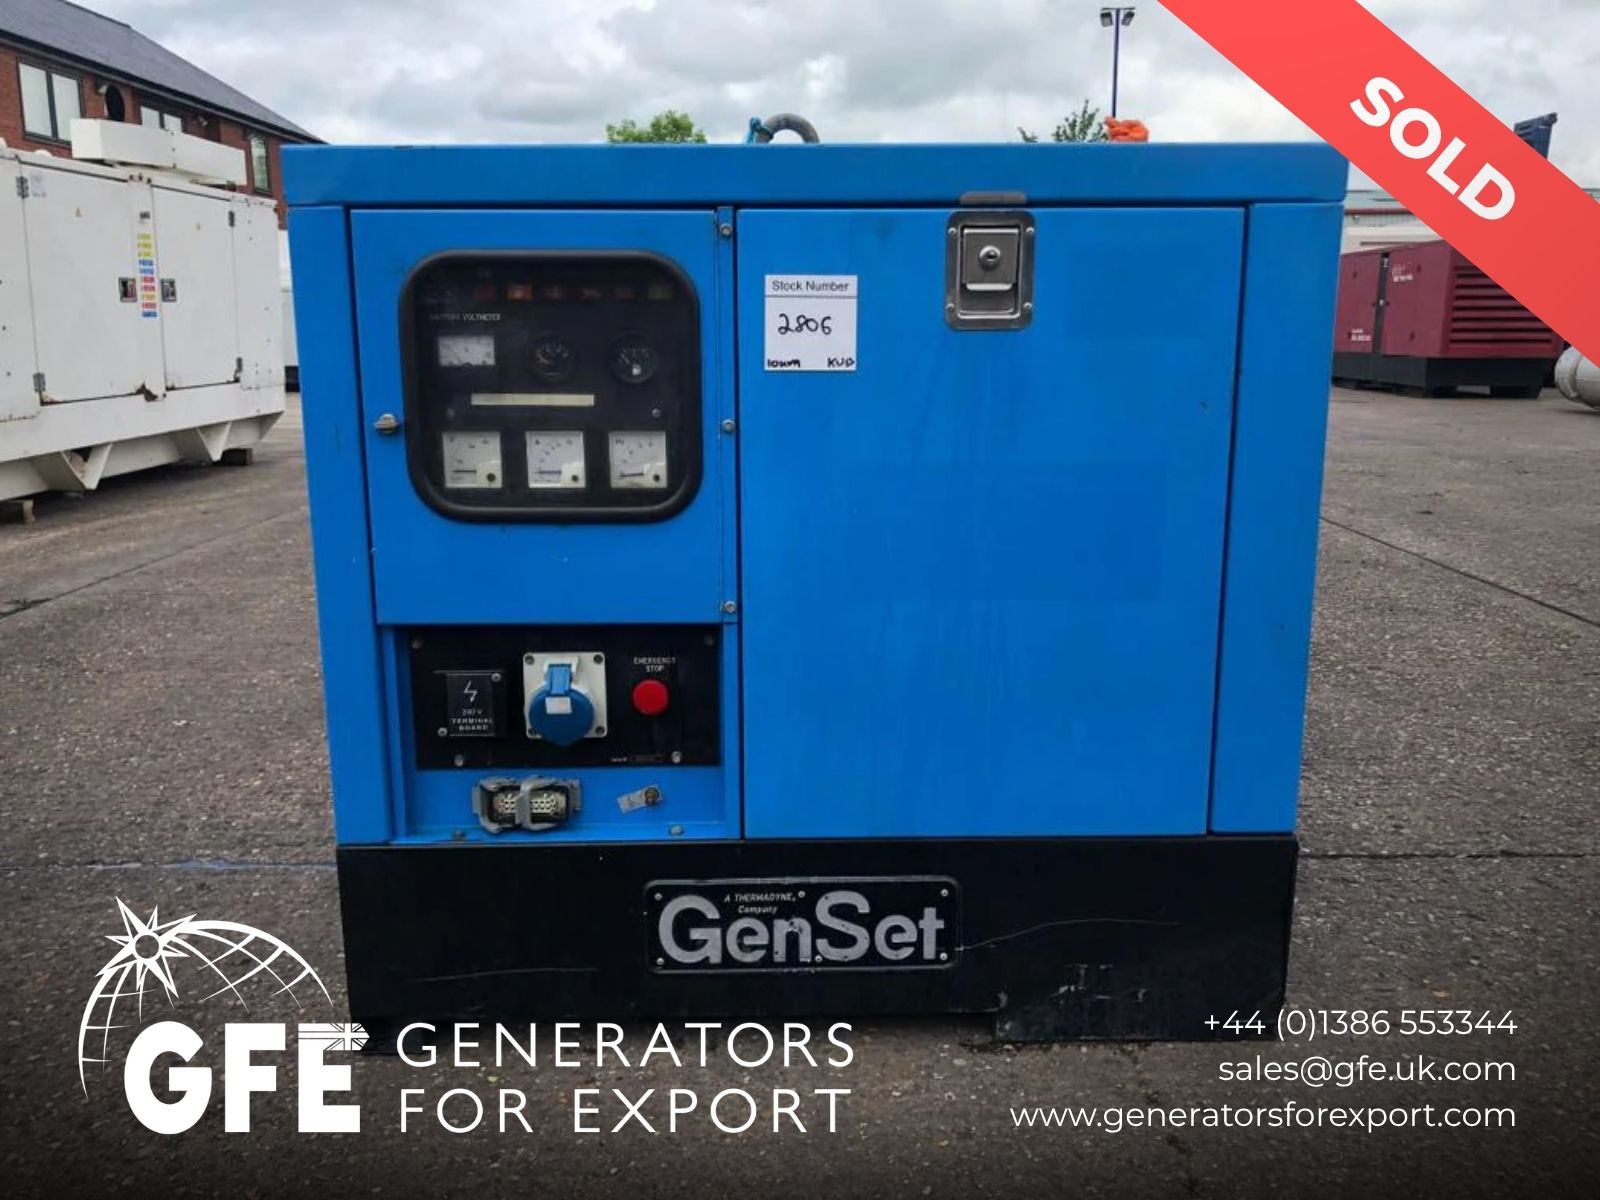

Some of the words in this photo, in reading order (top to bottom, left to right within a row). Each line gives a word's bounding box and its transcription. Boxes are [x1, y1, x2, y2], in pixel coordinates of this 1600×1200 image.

[772, 280, 802, 291] Stock
[805, 280, 849, 291] Number
[778, 313, 832, 335] 2806
[645, 665, 664, 673] STOP
[724, 894, 731, 903] A
[738, 905, 778, 915] Company
[658, 890, 945, 964] GenSet
